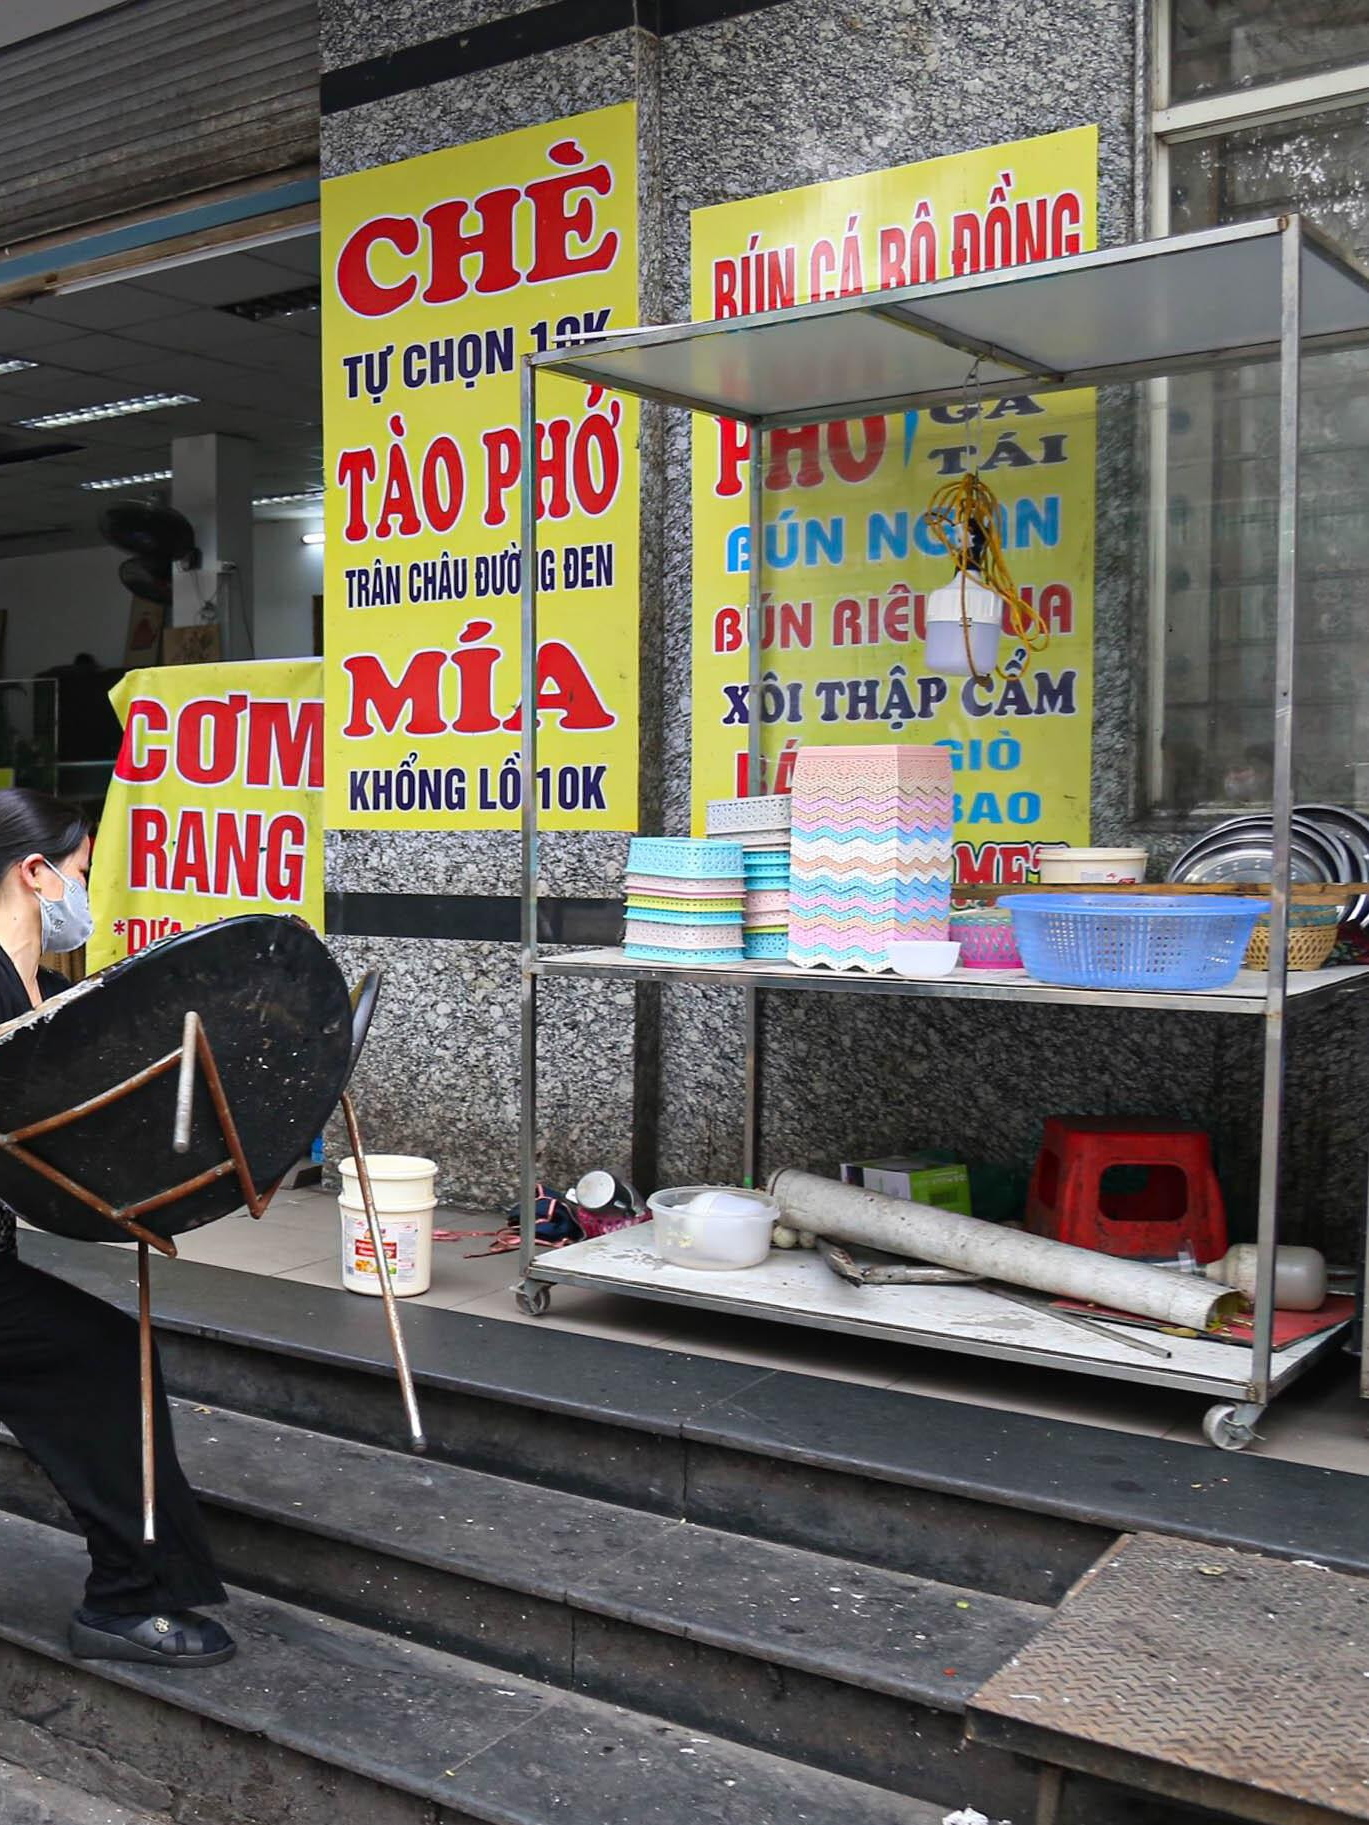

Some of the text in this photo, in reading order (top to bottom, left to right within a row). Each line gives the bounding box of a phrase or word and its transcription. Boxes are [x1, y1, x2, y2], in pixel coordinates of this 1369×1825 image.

[337, 140, 618, 317] CHÈ
[811, 214, 864, 304] CÁ
[952, 171, 1082, 277] ĐỒNG
[343, 309, 612, 405] TỰ CHỌN 10K
[338, 383, 622, 542] TÀO PHỚ
[927, 431, 1069, 475] TÁI
[345, 542, 614, 609] TRÂN CHÂU ĐƯỜG ĐEN
[726, 494, 1061, 574] BÚN NGN
[713, 592, 814, 654] BÚN
[343, 620, 617, 737] MÍA
[722, 649, 1078, 731] XÔI THẬP CẨM
[113, 691, 325, 791] CƠM
[350, 751, 608, 812] KHỔNG LỒ 10K
[129, 805, 307, 904] RANG
